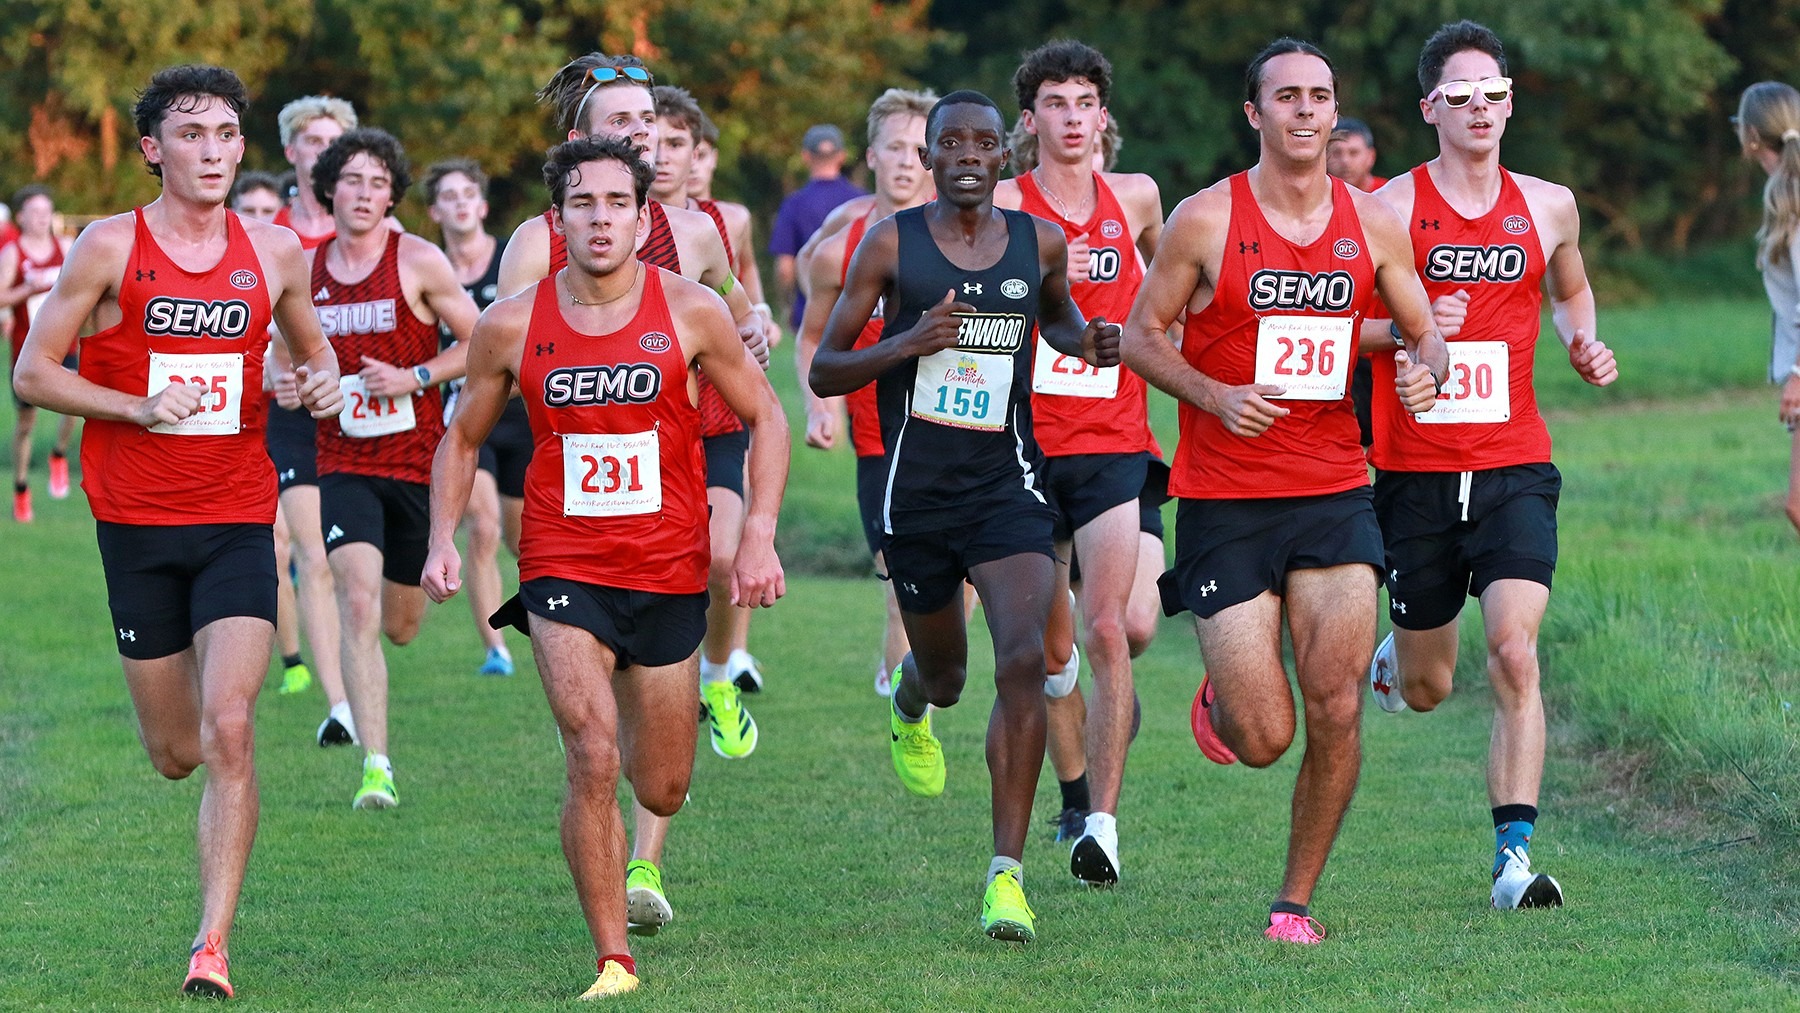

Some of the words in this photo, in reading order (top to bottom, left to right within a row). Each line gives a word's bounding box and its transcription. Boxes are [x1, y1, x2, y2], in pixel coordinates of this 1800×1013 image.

[1426, 247, 1524, 281] SEMO
[1251, 272, 1352, 309] SEMO
[146, 299, 248, 336] SEMO
[318, 300, 396, 336] SIUE
[957, 317, 1023, 347] ENWOOD
[1274, 336, 1336, 376] 236
[546, 366, 658, 405] SEMO
[933, 384, 991, 420] 159
[580, 454, 643, 494] 231
